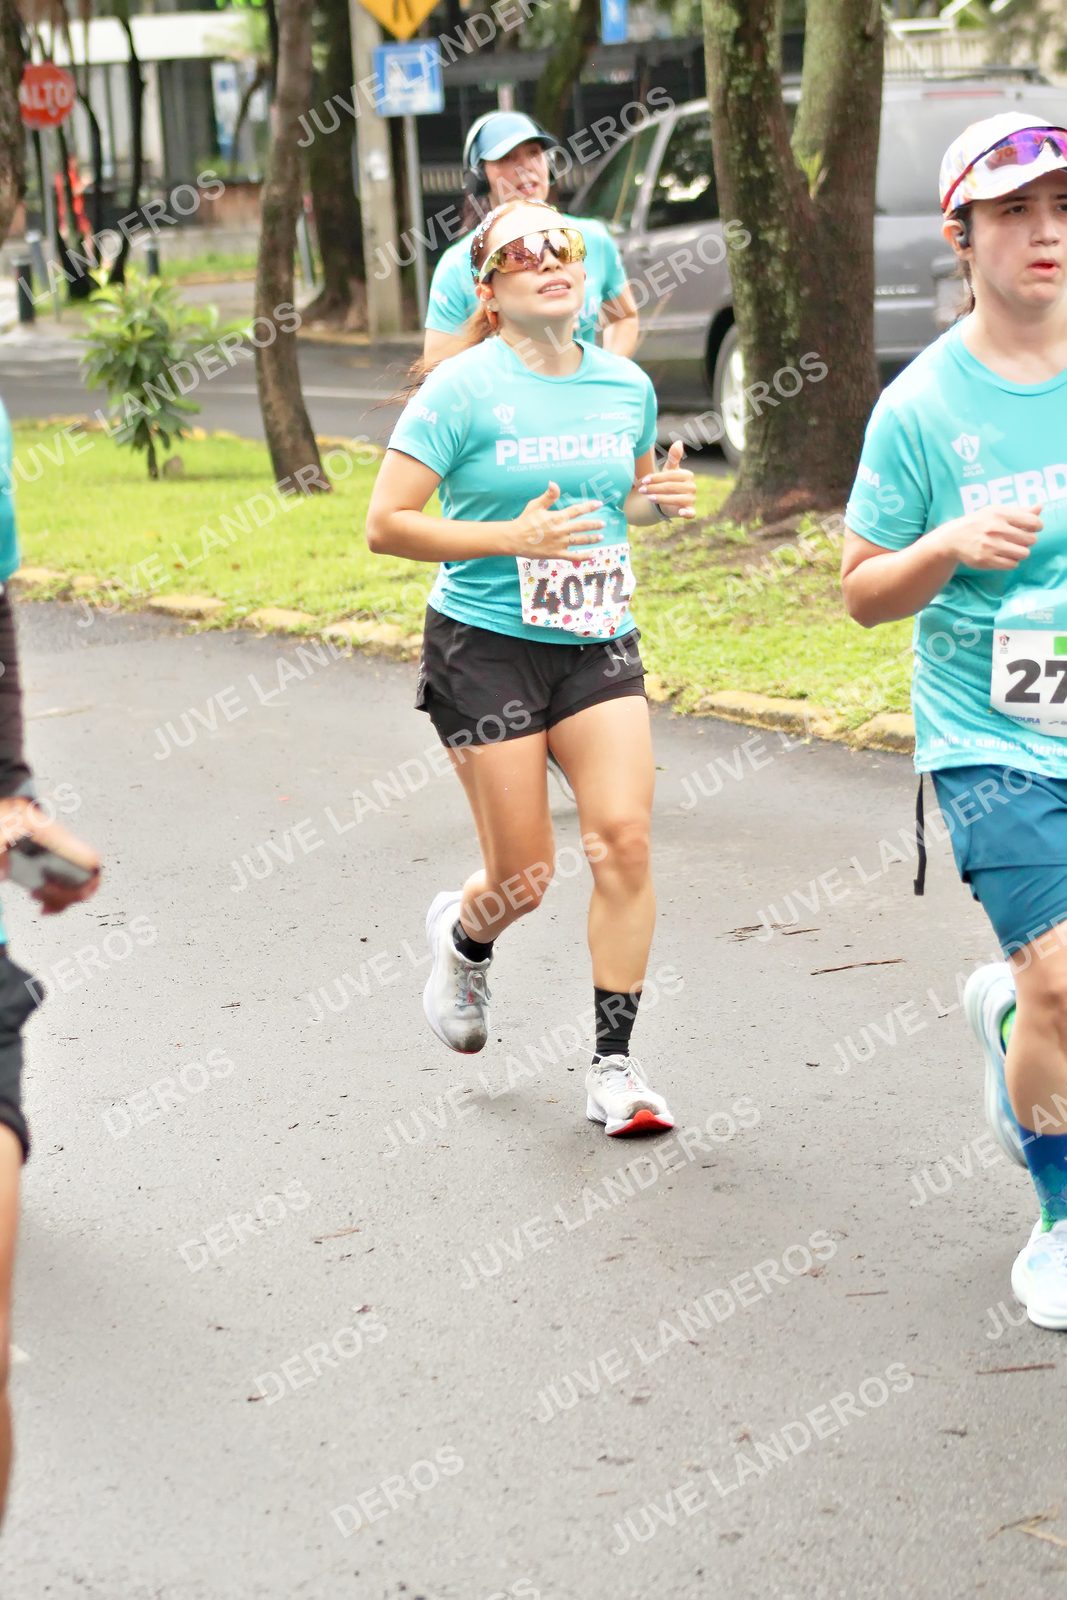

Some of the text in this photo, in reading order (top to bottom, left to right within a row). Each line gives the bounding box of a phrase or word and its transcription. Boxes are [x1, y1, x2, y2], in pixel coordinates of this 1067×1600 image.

[18, 81, 73, 109] ALTO
[495, 433, 635, 466] PERDURA
[959, 464, 1067, 515] PERD
[531, 567, 630, 615] 4072
[1005, 659, 1067, 704] 27
